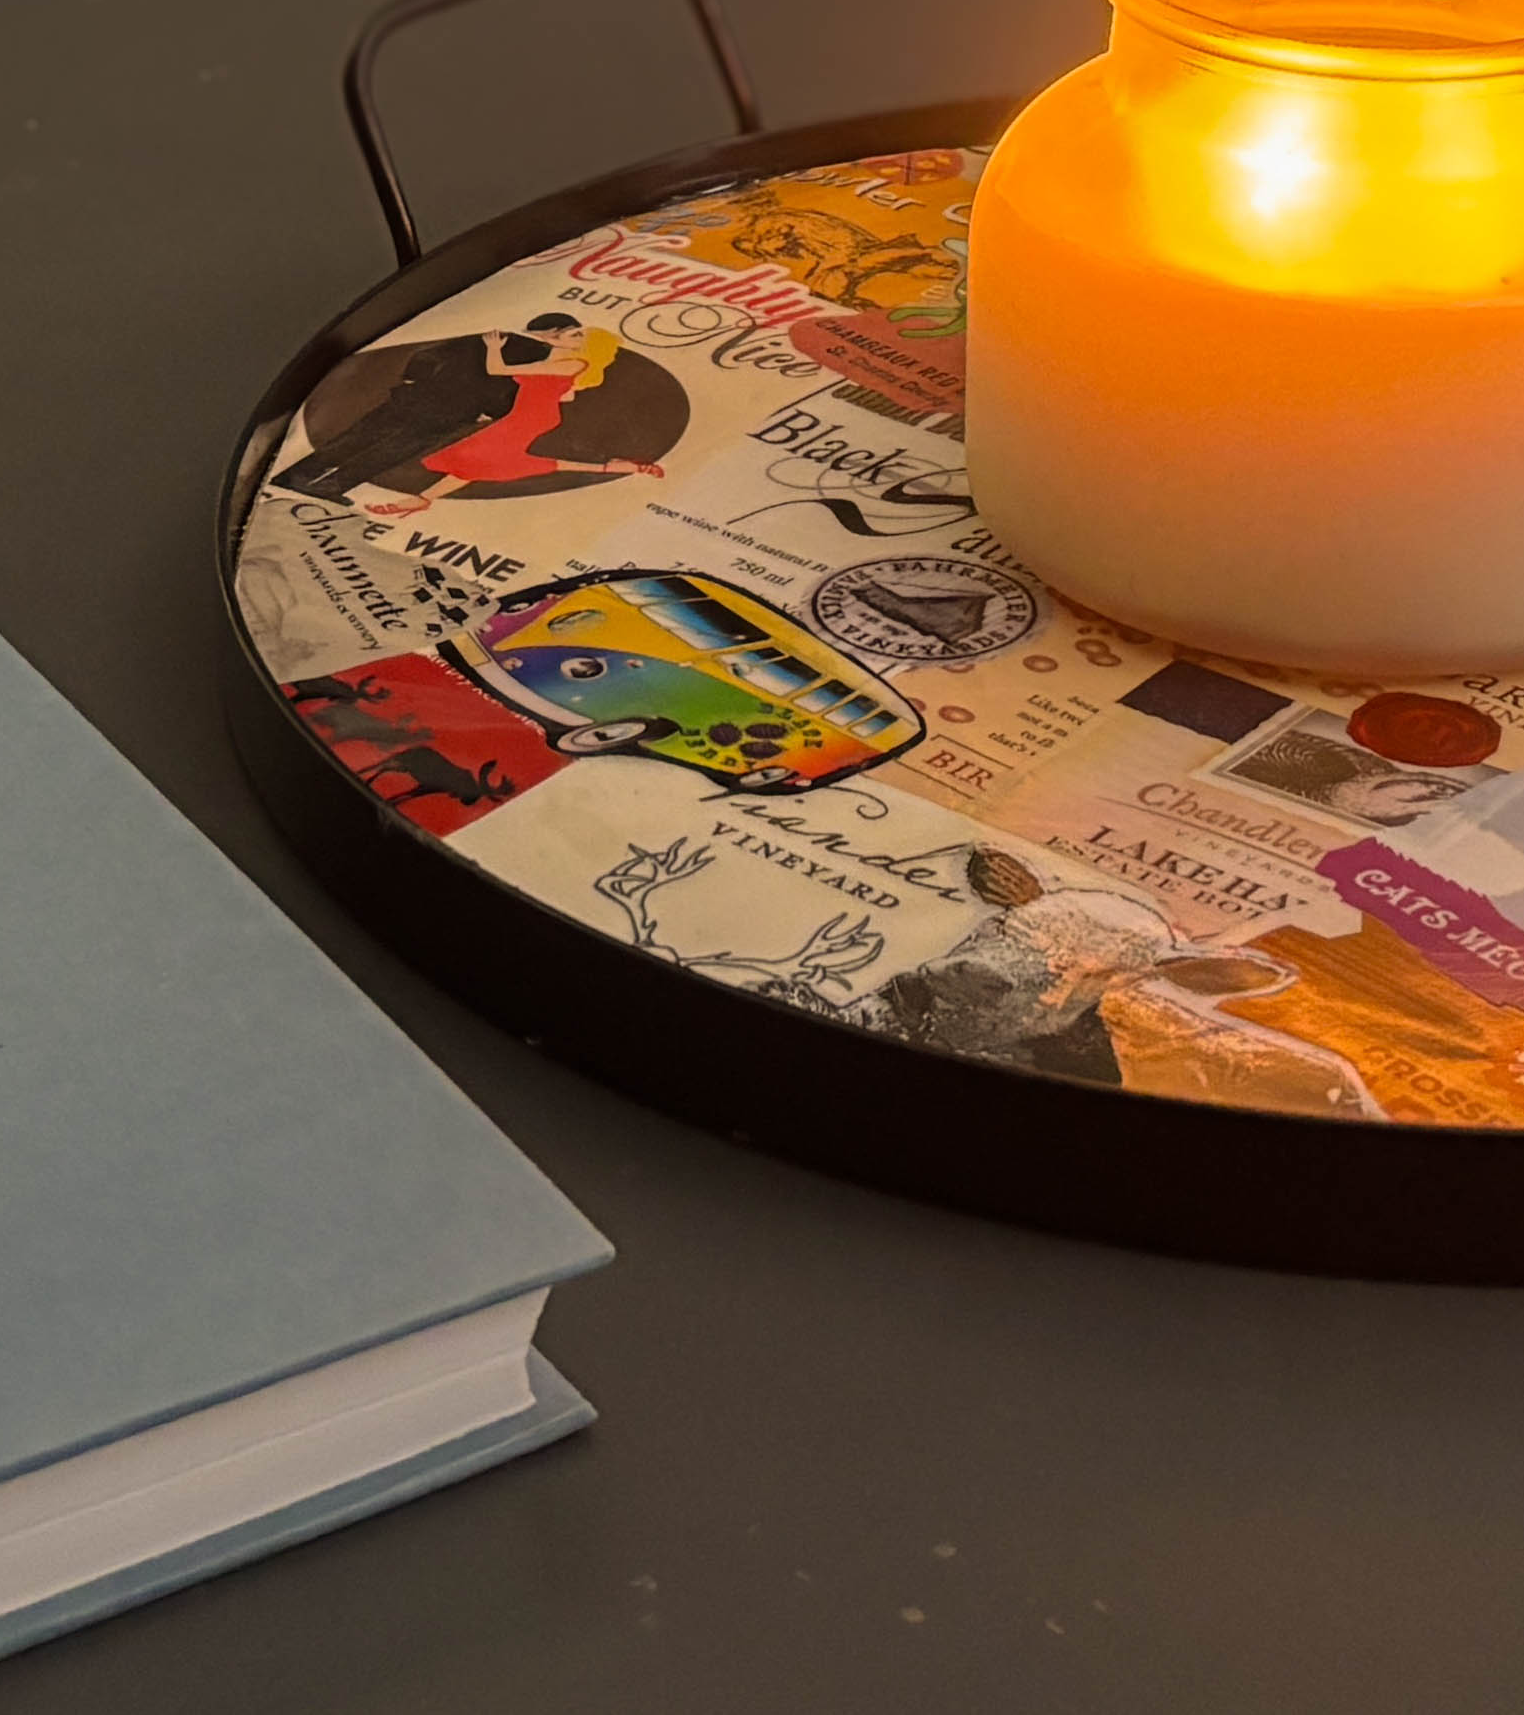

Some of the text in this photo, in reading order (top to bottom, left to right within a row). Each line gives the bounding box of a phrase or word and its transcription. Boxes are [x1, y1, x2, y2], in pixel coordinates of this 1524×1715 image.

[558, 286, 632, 310] BUT
[621, 301, 822, 379] Nice
[747, 408, 915, 486] Black
[290, 502, 408, 632] Chaumette
[404, 530, 526, 582] WINE
[721, 524, 754, 547] with
[754, 540, 811, 569] natural
[729, 556, 766, 577] 750
[766, 571, 795, 588] ml
[840, 623, 1008, 657] VINEYARDS
[922, 748, 995, 792] BIR
[1135, 781, 1328, 861] Chandler
[711, 821, 901, 909] VINEYARD
[1046, 834, 1179, 894] ESTATE
[1084, 825, 1309, 912] LAKE HA
[1353, 867, 1461, 931] CATS
